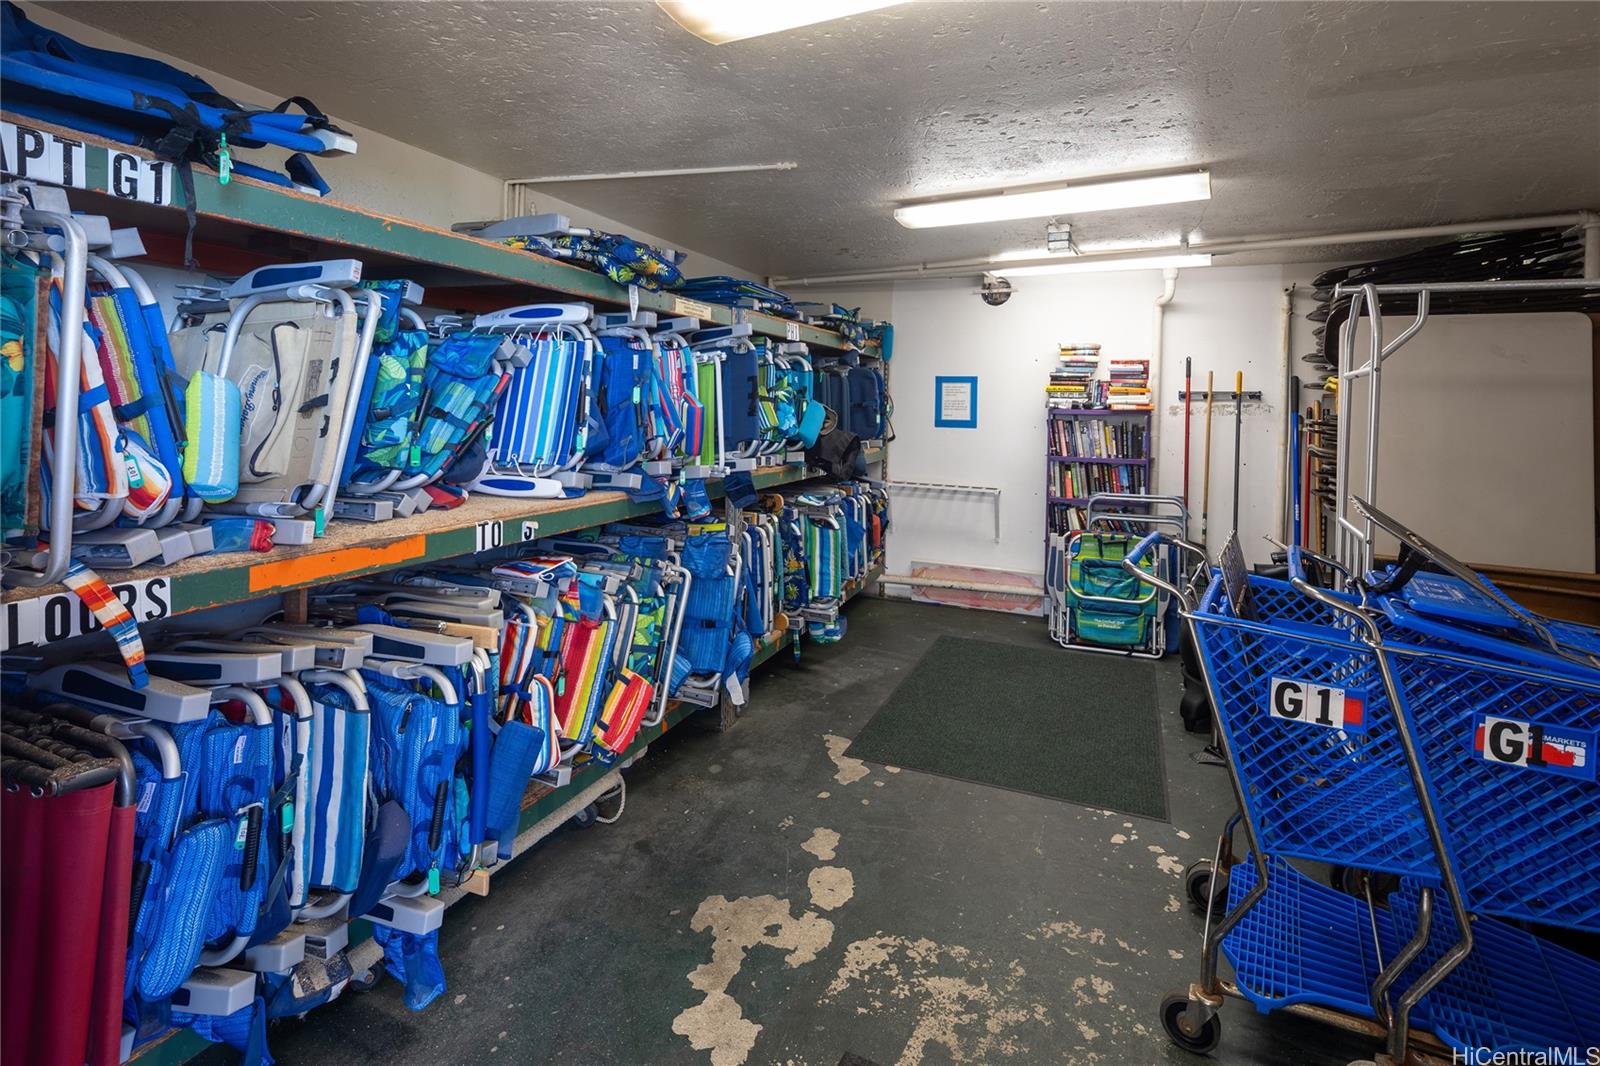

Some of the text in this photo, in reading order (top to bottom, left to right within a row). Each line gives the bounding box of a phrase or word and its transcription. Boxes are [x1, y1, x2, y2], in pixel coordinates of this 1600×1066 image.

[112, 153, 165, 205] G1
[478, 520, 501, 550] TO
[1275, 681, 1334, 727] G1
[1489, 721, 1548, 768] G1
